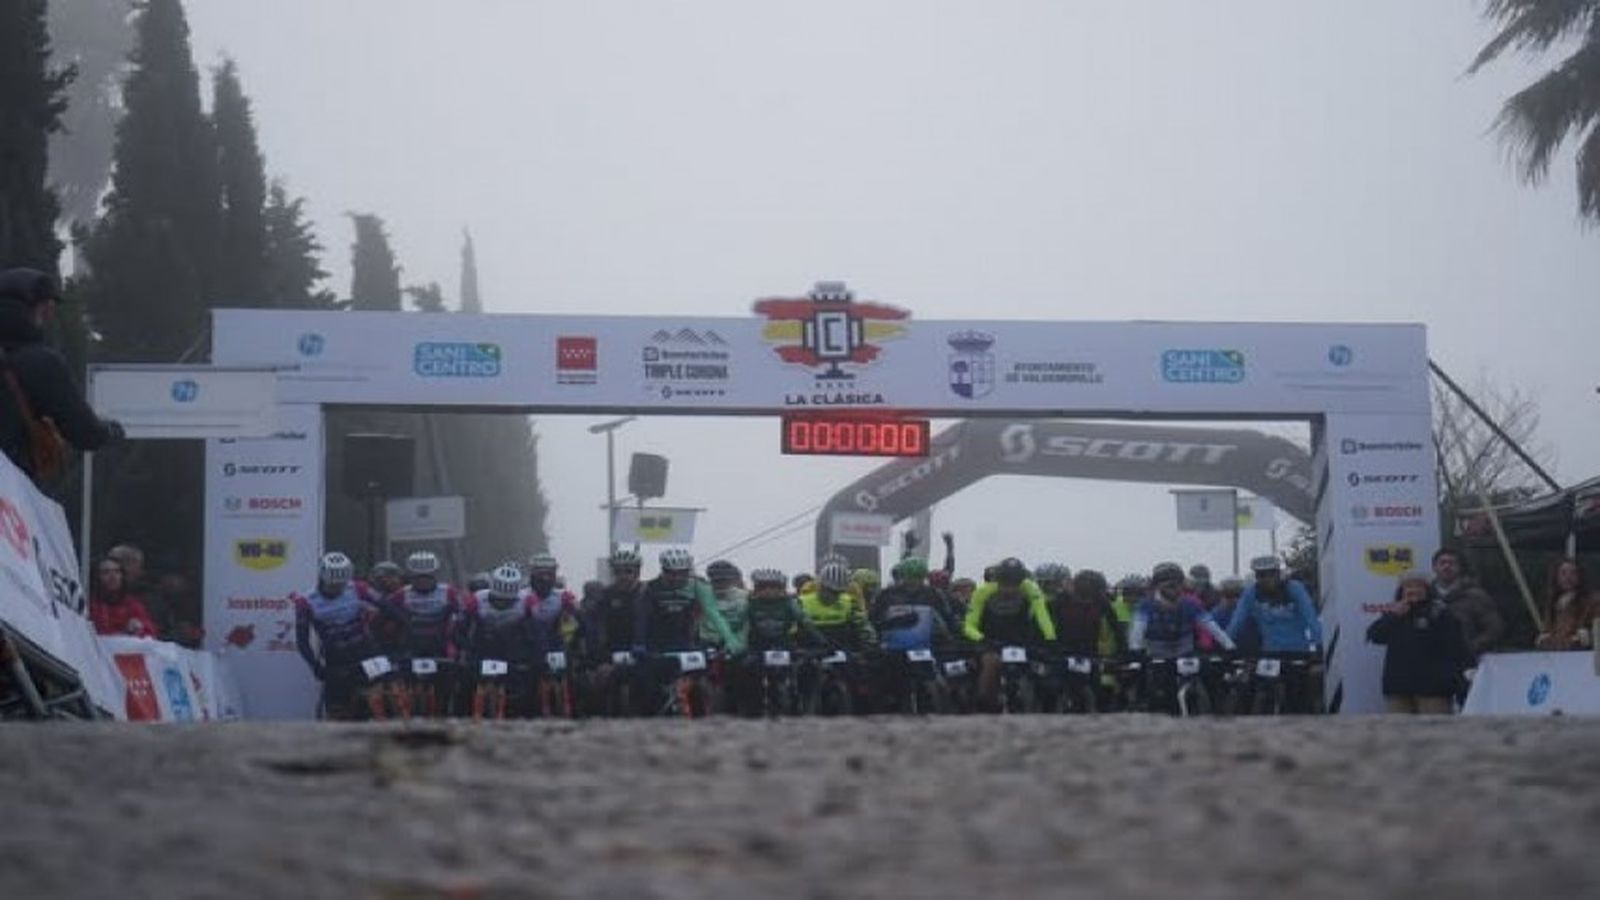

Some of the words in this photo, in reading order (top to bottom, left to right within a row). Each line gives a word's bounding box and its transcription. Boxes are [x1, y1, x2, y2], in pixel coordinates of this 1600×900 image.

[420, 343, 466, 359] SANI
[1166, 351, 1211, 368] SANI
[420, 361, 497, 374] CENTRO
[1166, 369, 1241, 381] CENTRO
[785, 394, 806, 405] LA
[812, 392, 884, 405] CLÁSICA
[1041, 436, 1238, 464] SCOTT
[248, 498, 302, 509] BOSCH
[1374, 506, 1422, 517] BOSCH
